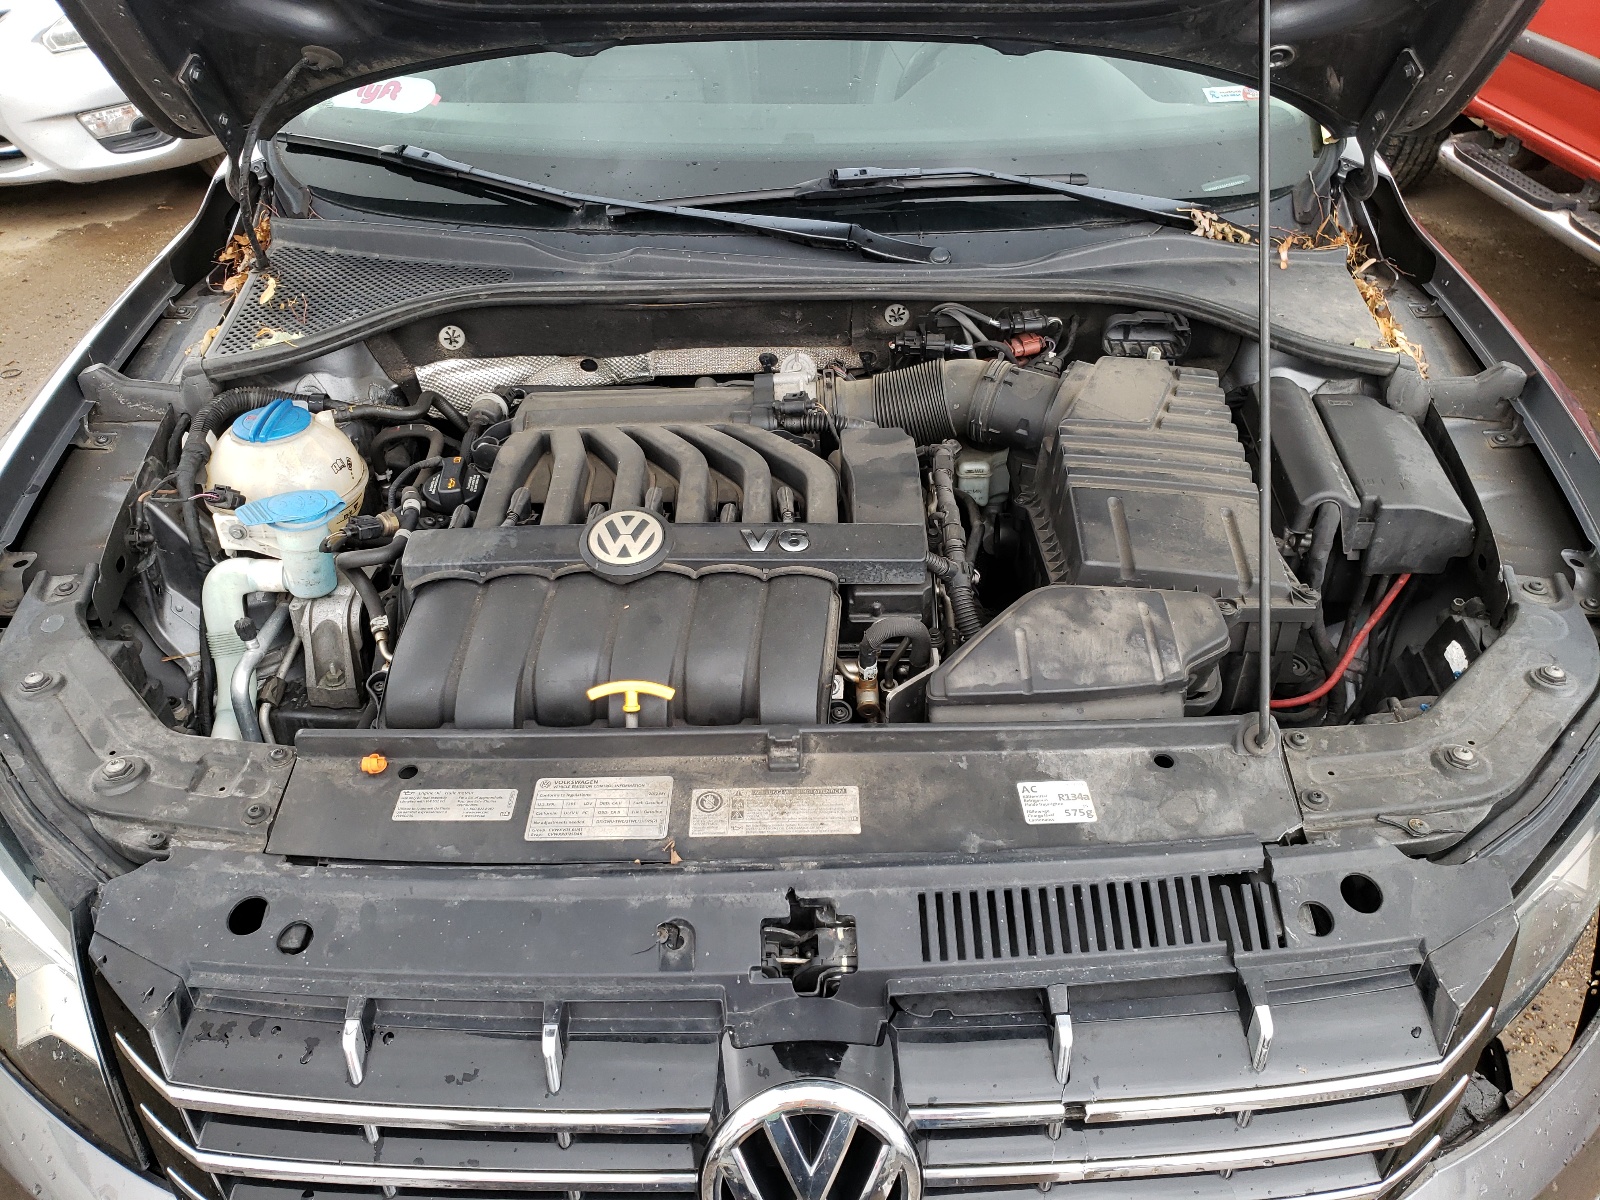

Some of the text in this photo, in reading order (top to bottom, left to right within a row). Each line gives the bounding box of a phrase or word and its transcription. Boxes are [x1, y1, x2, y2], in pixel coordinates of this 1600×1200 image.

[740, 528, 812, 553] V6
[1021, 785, 1038, 794] AC
[1057, 793, 1091, 801] R134a
[1064, 808, 1094, 819] 575g
